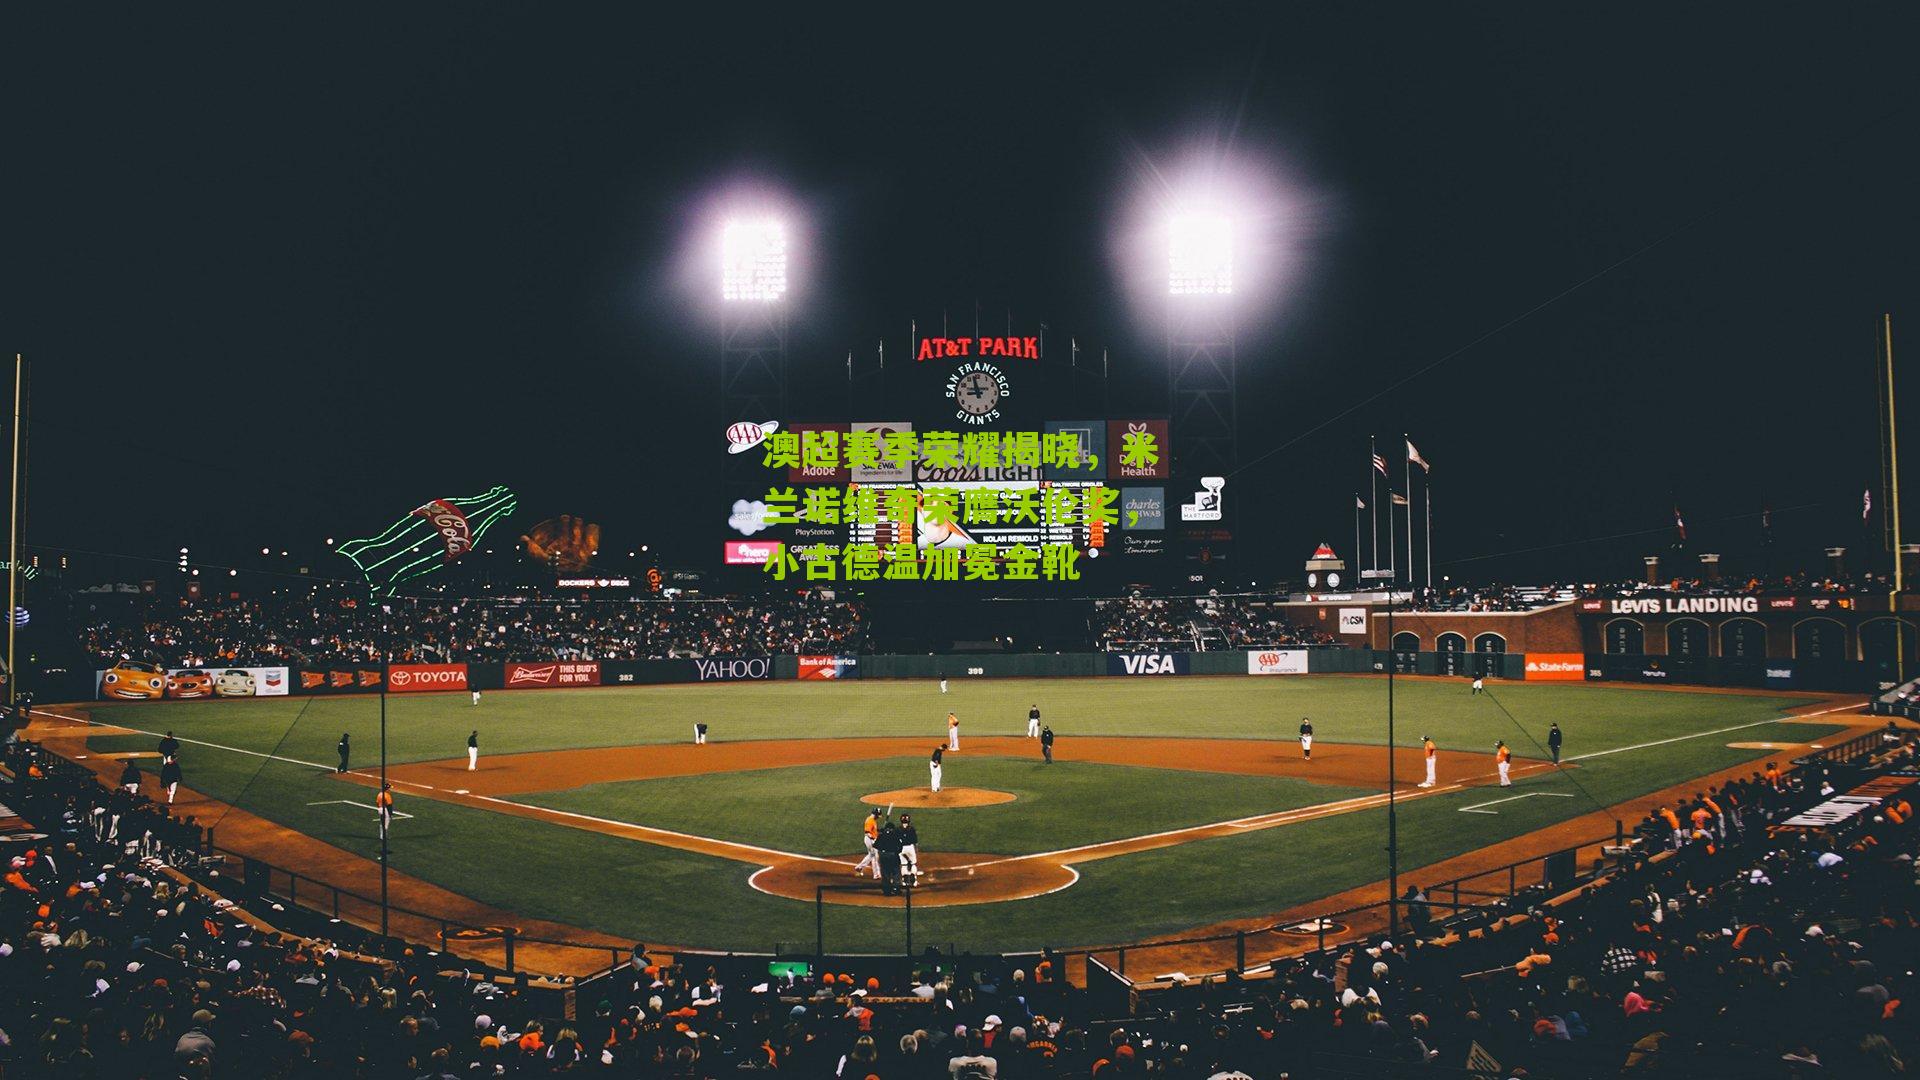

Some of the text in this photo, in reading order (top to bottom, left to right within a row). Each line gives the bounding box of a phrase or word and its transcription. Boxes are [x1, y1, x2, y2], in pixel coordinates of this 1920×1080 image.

[917, 336, 1038, 361] AT&T PARK
[945, 374, 960, 398] SAN
[958, 361, 1010, 397] FRANCISCO
[956, 408, 1001, 425] GIANTS
[915, 457, 982, 481] Coors
[1121, 466, 1156, 477] Health
[1125, 498, 1161, 510] charles
[1125, 510, 1162, 518] SHWAB
[434, 513, 471, 556] Cola
[795, 529, 835, 538] PlayStation
[982, 535, 1039, 543] NOLAN REIMOLD
[558, 579, 630, 587] DOCKERS DECK
[1665, 597, 1758, 613] LANDING
[1350, 616, 1364, 625] CSN
[800, 658, 818, 666] Bank
[826, 658, 856, 666] America
[1119, 654, 1176, 675] VISA
[559, 664, 597, 673] THIS BUD'S
[695, 658, 771, 681] YAHOO!
[413, 672, 466, 682] TOYOTA
[514, 670, 552, 679] Budweiser
[574, 674, 591, 682] YOU.
